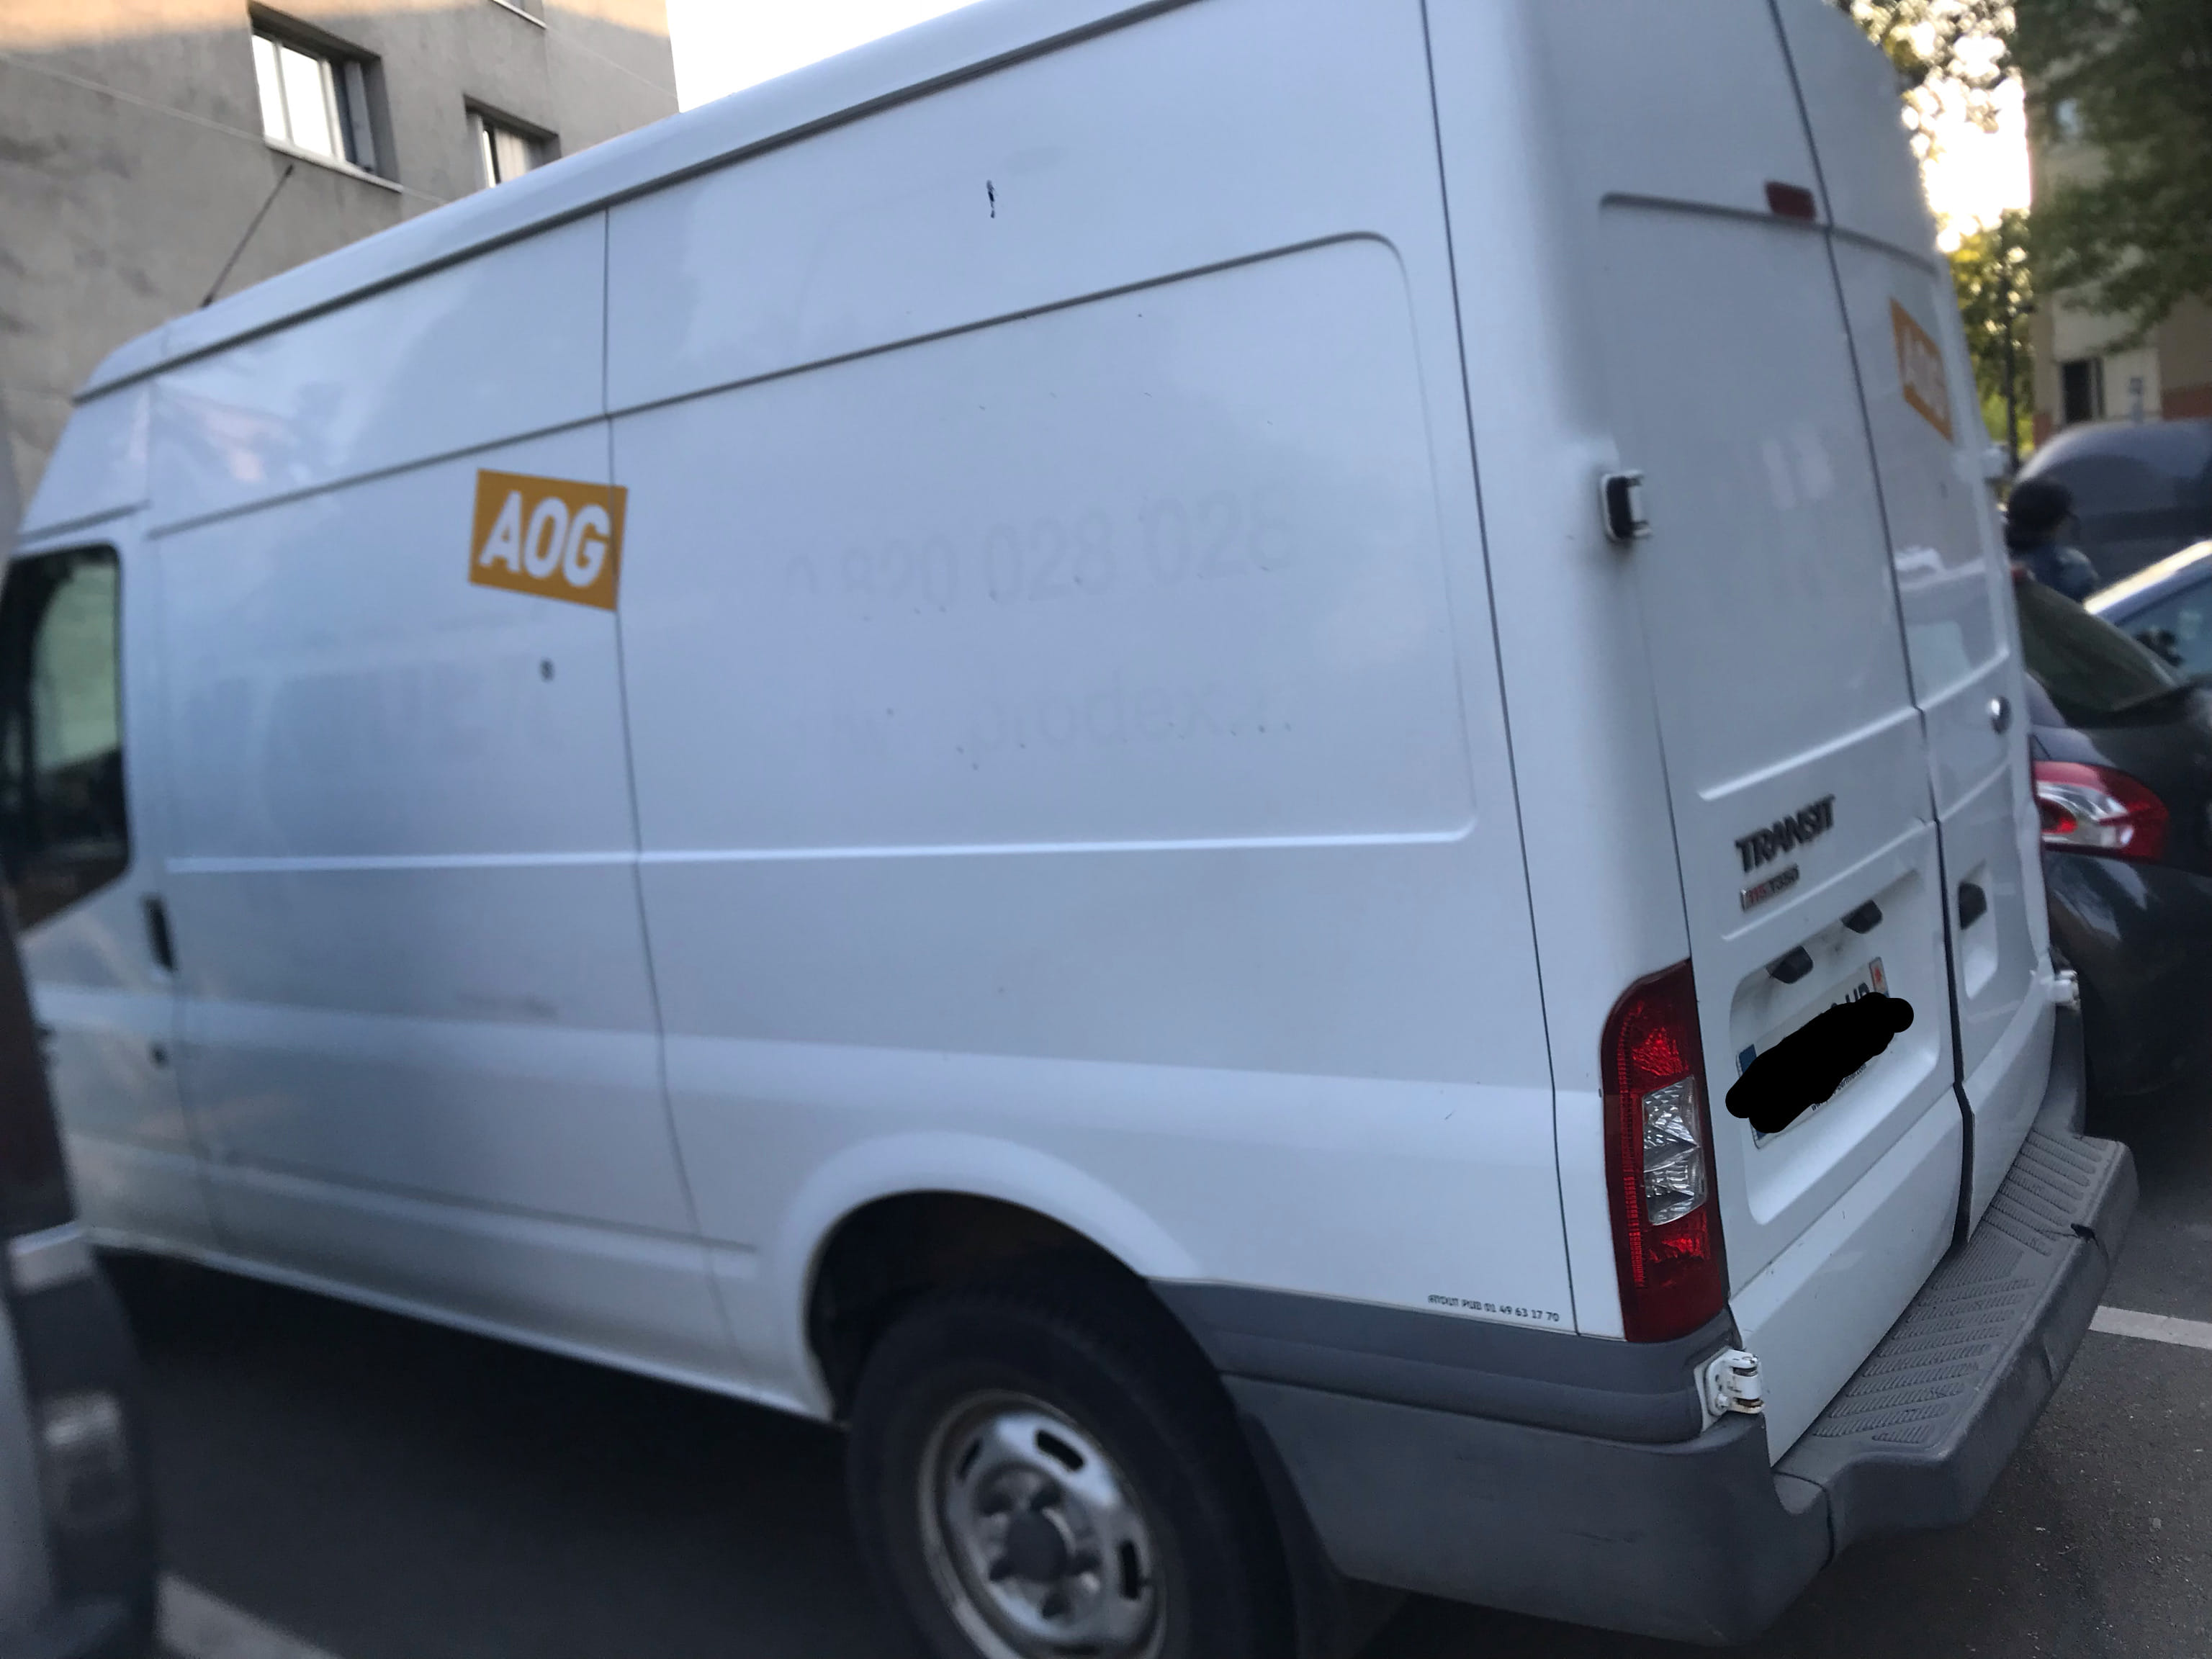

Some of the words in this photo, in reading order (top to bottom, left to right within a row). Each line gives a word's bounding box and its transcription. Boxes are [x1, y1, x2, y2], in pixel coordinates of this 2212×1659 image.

[477, 489, 611, 589] AOG
[982, 507, 1117, 606] 028
[1735, 792, 1836, 874] TRANSIT
[1483, 1303, 1497, 1313] 01
[1499, 1305, 1513, 1316] 49
[1514, 1307, 1529, 1318] 63
[1531, 1309, 1543, 1320] 17
[1546, 1311, 1560, 1322] 70
